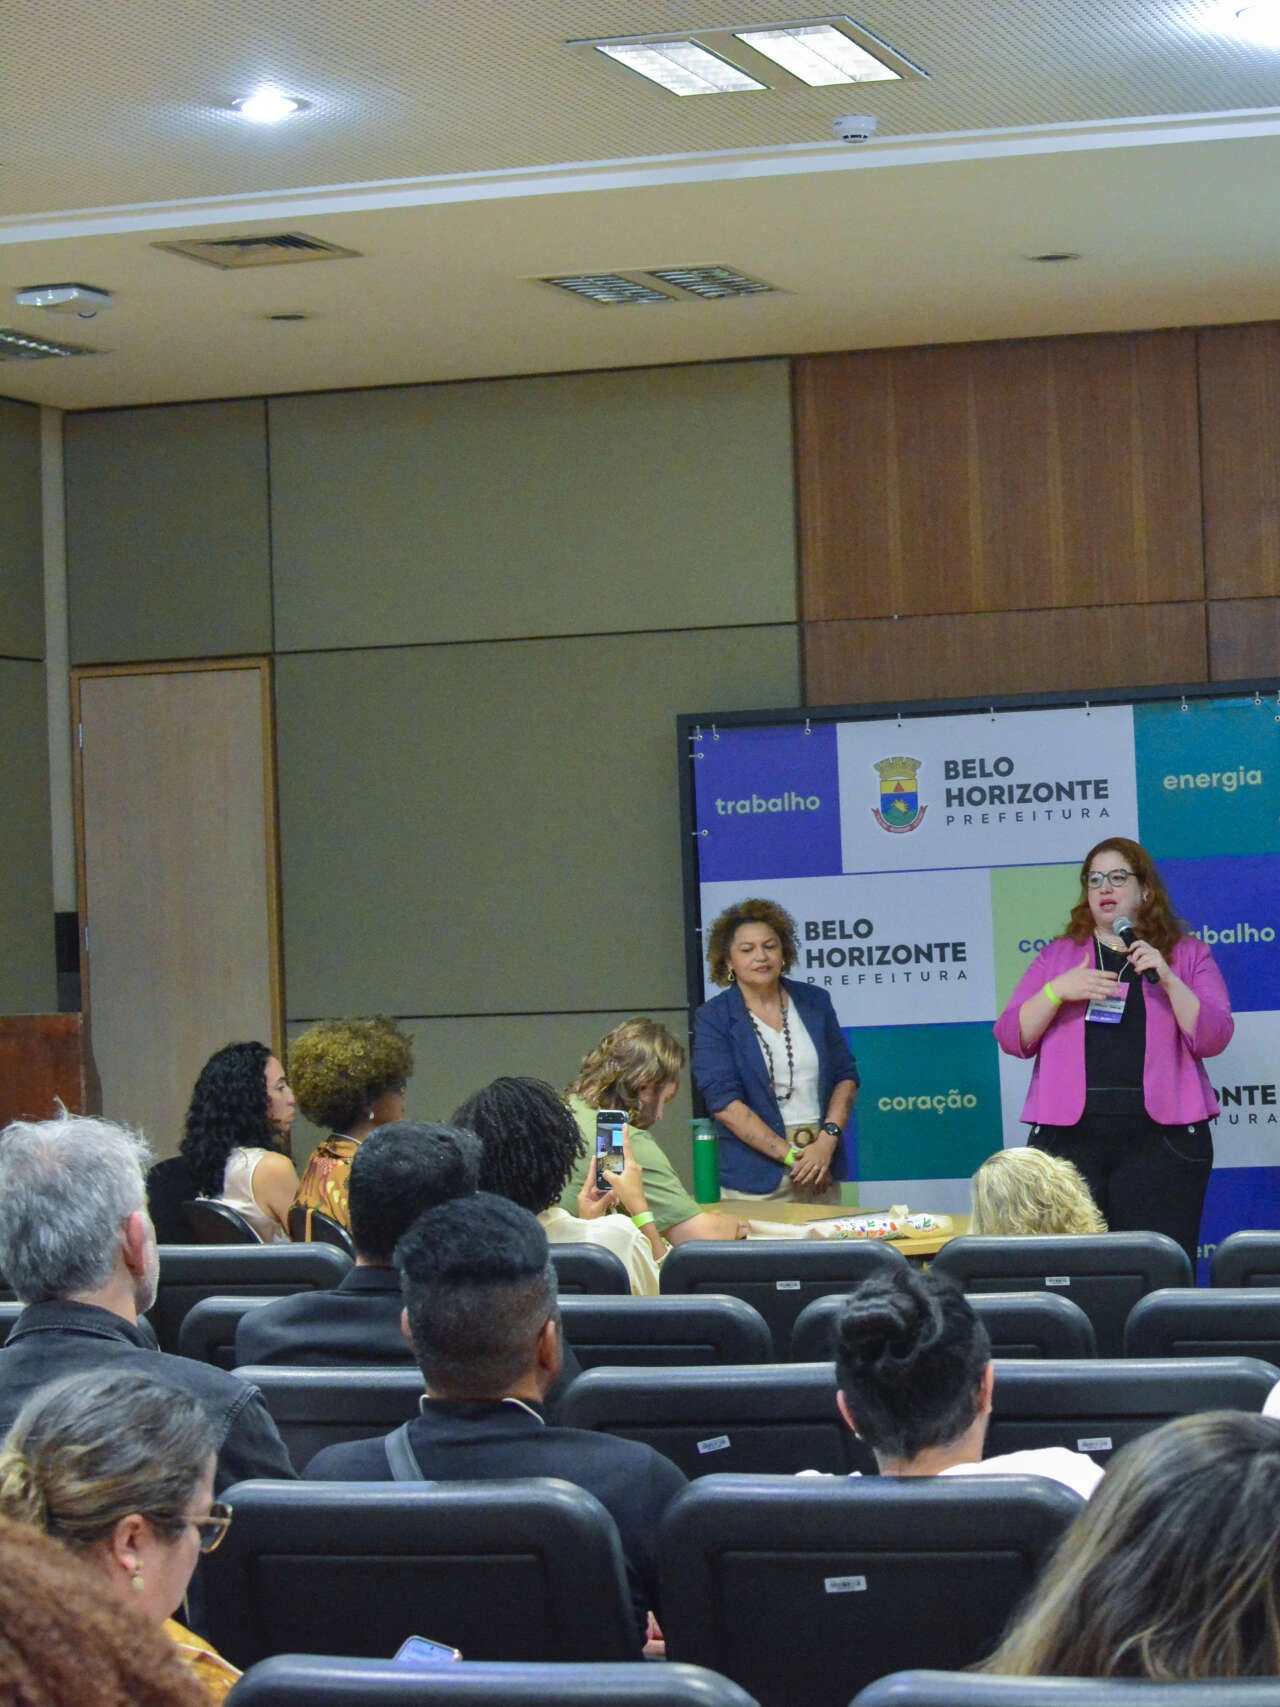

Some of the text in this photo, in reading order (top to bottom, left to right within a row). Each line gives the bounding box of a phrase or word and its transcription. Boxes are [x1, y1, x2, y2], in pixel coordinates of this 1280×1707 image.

[944, 756, 1015, 781] BELO
[1163, 766, 1262, 792] energia
[715, 791, 820, 815] trabalho
[945, 779, 1109, 808] HORIZONTE
[946, 807, 1110, 827] PREFEITURA
[805, 918, 874, 941] BELO
[806, 942, 967, 969] HORIZONTE
[807, 970, 968, 986] PREFEITURA
[878, 1089, 977, 1115] coração
